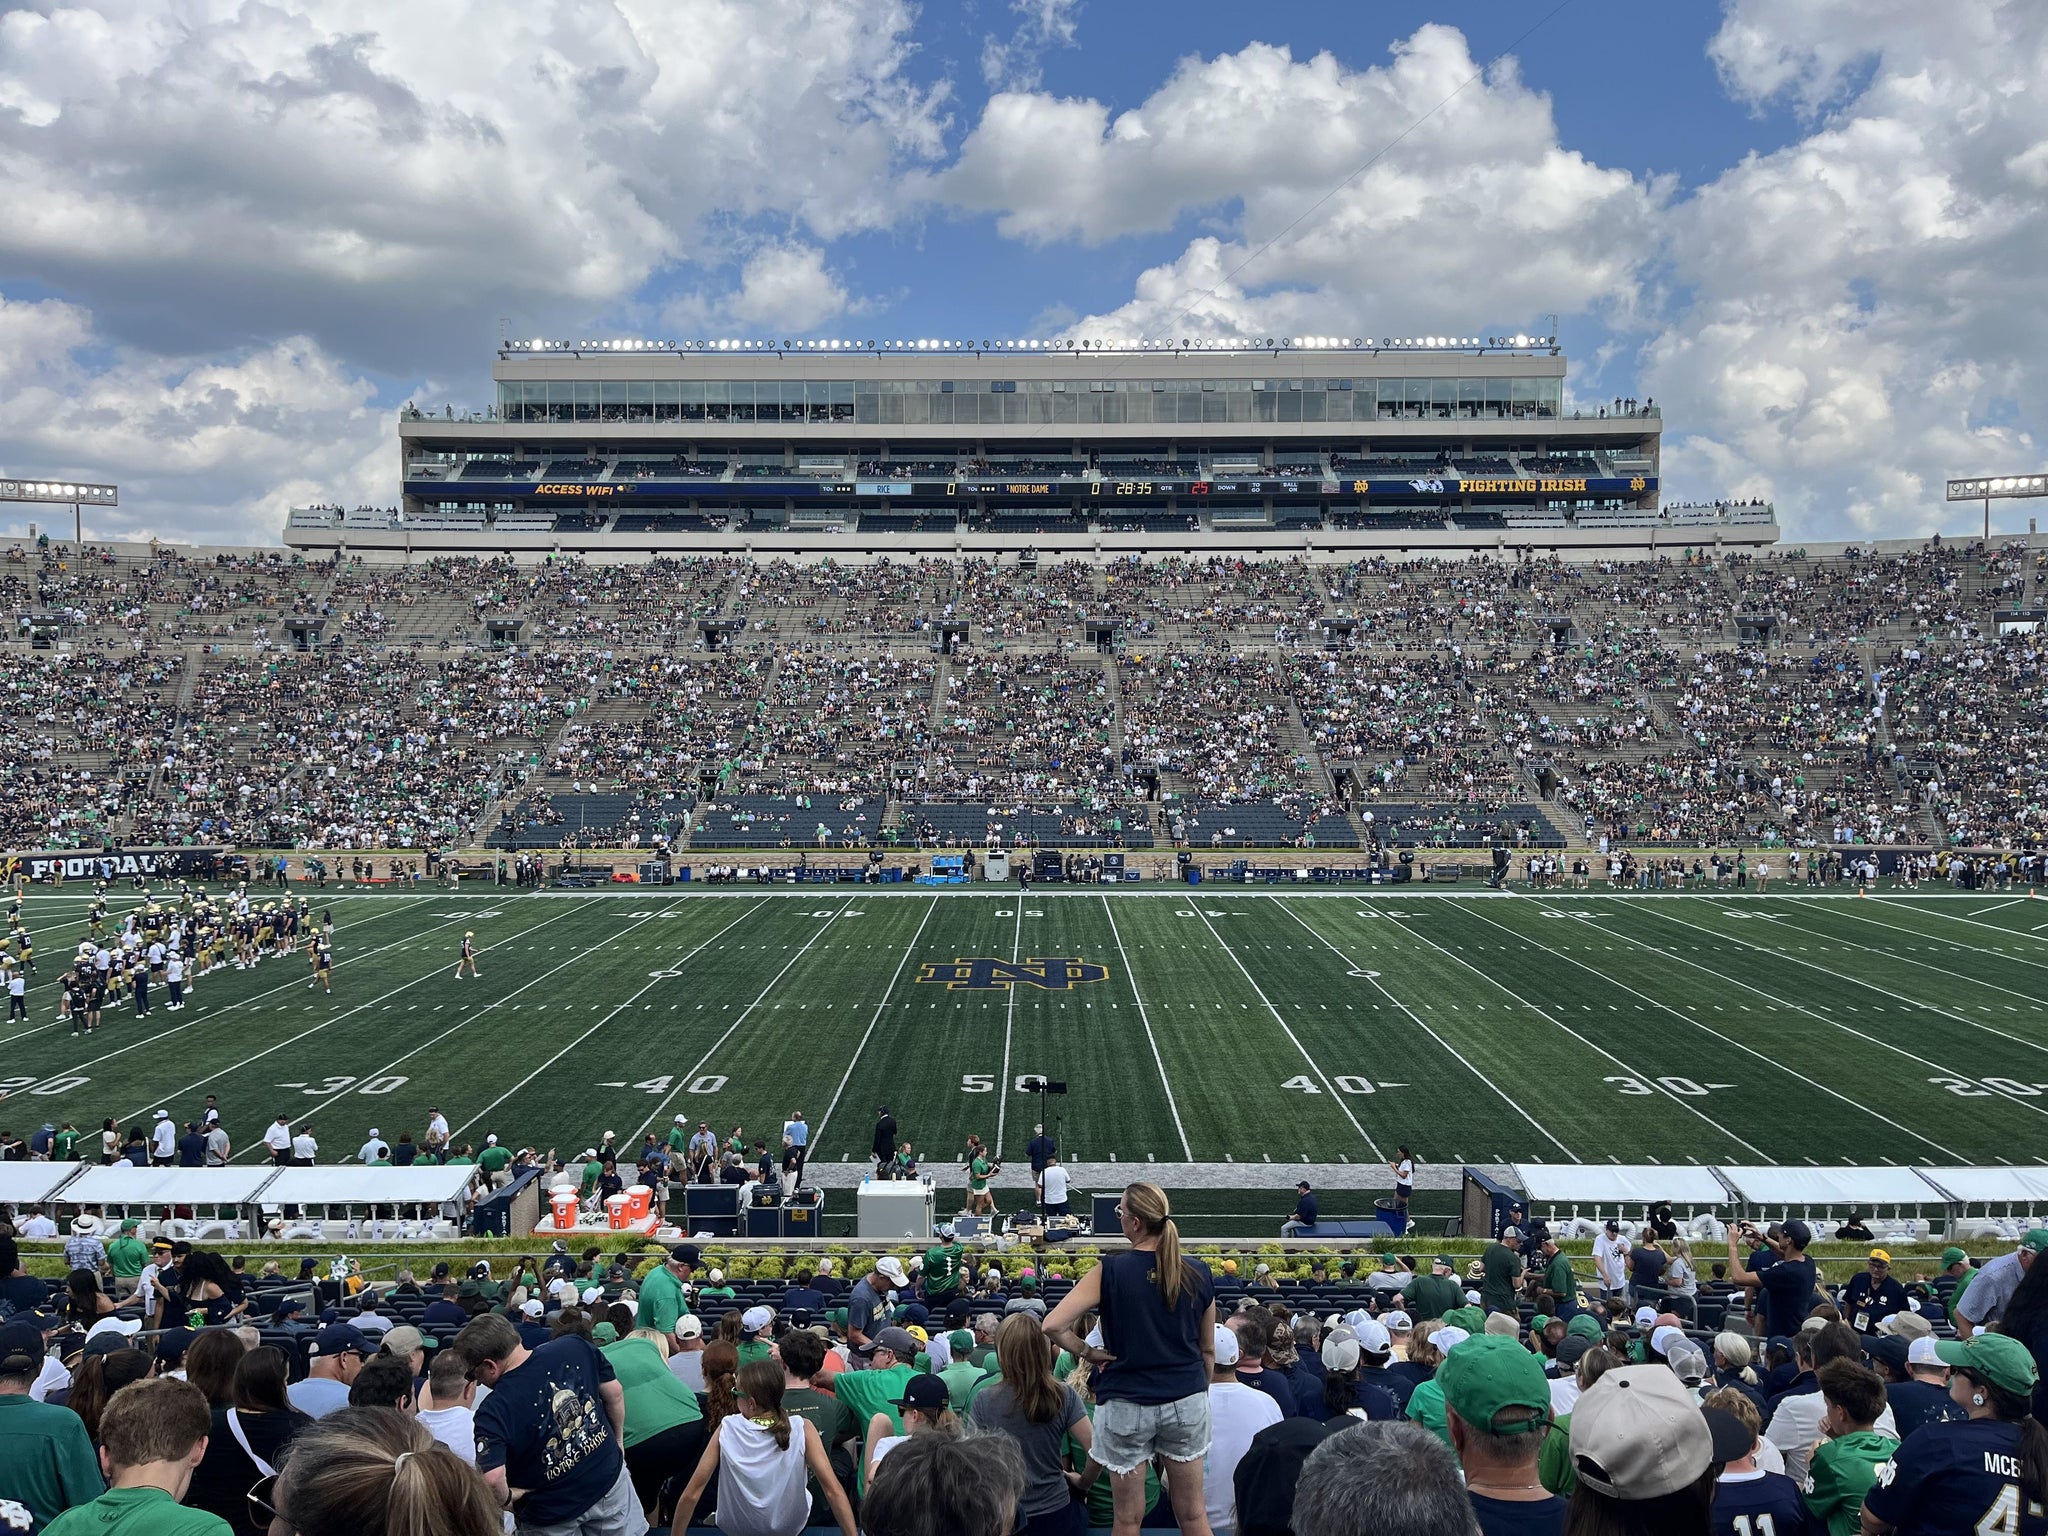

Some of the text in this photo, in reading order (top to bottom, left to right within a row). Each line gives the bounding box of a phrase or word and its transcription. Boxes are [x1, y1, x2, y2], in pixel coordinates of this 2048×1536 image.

[535, 484, 583, 494] ACCESS
[586, 485, 614, 495] WIFI
[877, 485, 890, 494] RICE
[1009, 484, 1030, 494] NOTRE
[1031, 484, 1049, 494] DAME
[1116, 482, 1152, 495] 28:35
[1191, 482, 1208, 495] 25
[1459, 479, 1586, 492] FIGHTING IRISH
[302, 1075, 410, 1095] 30
[632, 1074, 730, 1094] 40
[960, 1074, 1050, 1093] 50
[1280, 1074, 1377, 1094] 40
[1603, 1075, 1710, 1096] 30
[1928, 1077, 2042, 1096] 20
[66, 1136, 71, 1149] 1
[631, 1198, 640, 1208] G
[557, 1206, 566, 1216] G
[612, 1206, 621, 1216] G
[590, 1411, 597, 1424] 2
[545, 1453, 554, 1465] 1
[1984, 1451, 2024, 1478] MCB
